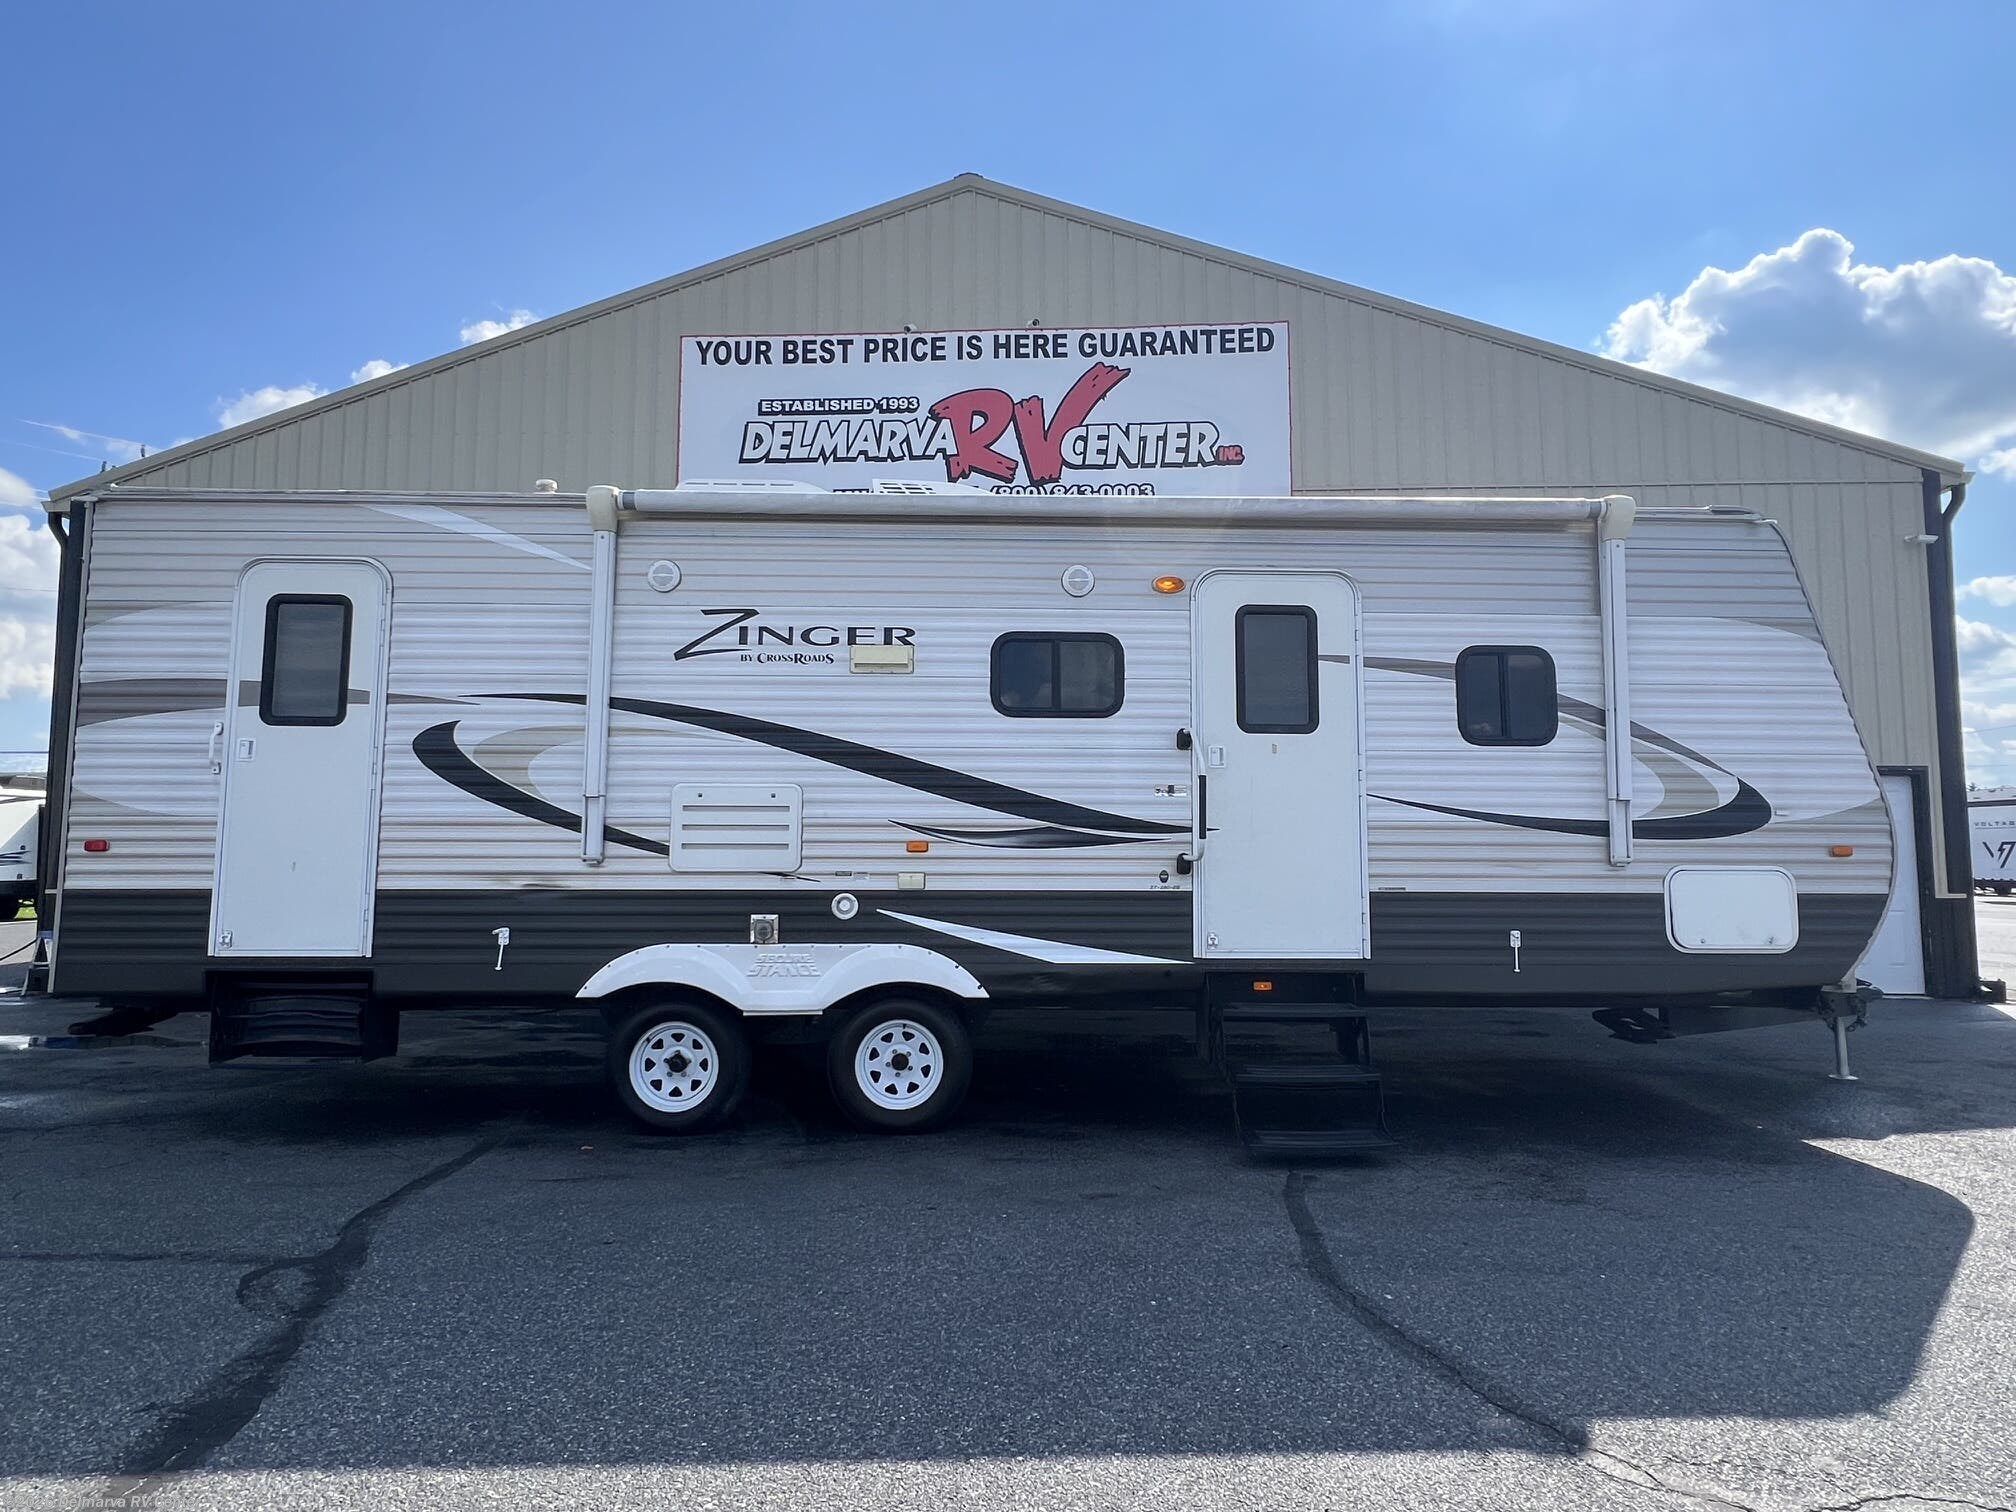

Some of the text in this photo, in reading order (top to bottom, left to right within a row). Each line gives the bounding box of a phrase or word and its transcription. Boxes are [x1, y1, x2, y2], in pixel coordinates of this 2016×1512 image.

[697, 327, 1276, 366] YOUR BEST PRICE IS HERE GUARANTEED
[759, 396, 920, 414] ESTABLISHED 1993
[739, 417, 958, 464] DELMARVA
[928, 361, 1131, 486] RV
[1060, 421, 1222, 470] CENTER
[673, 608, 917, 662] ZINGER
[740, 653, 754, 663] BY
[746, 963, 822, 978] STANCE
